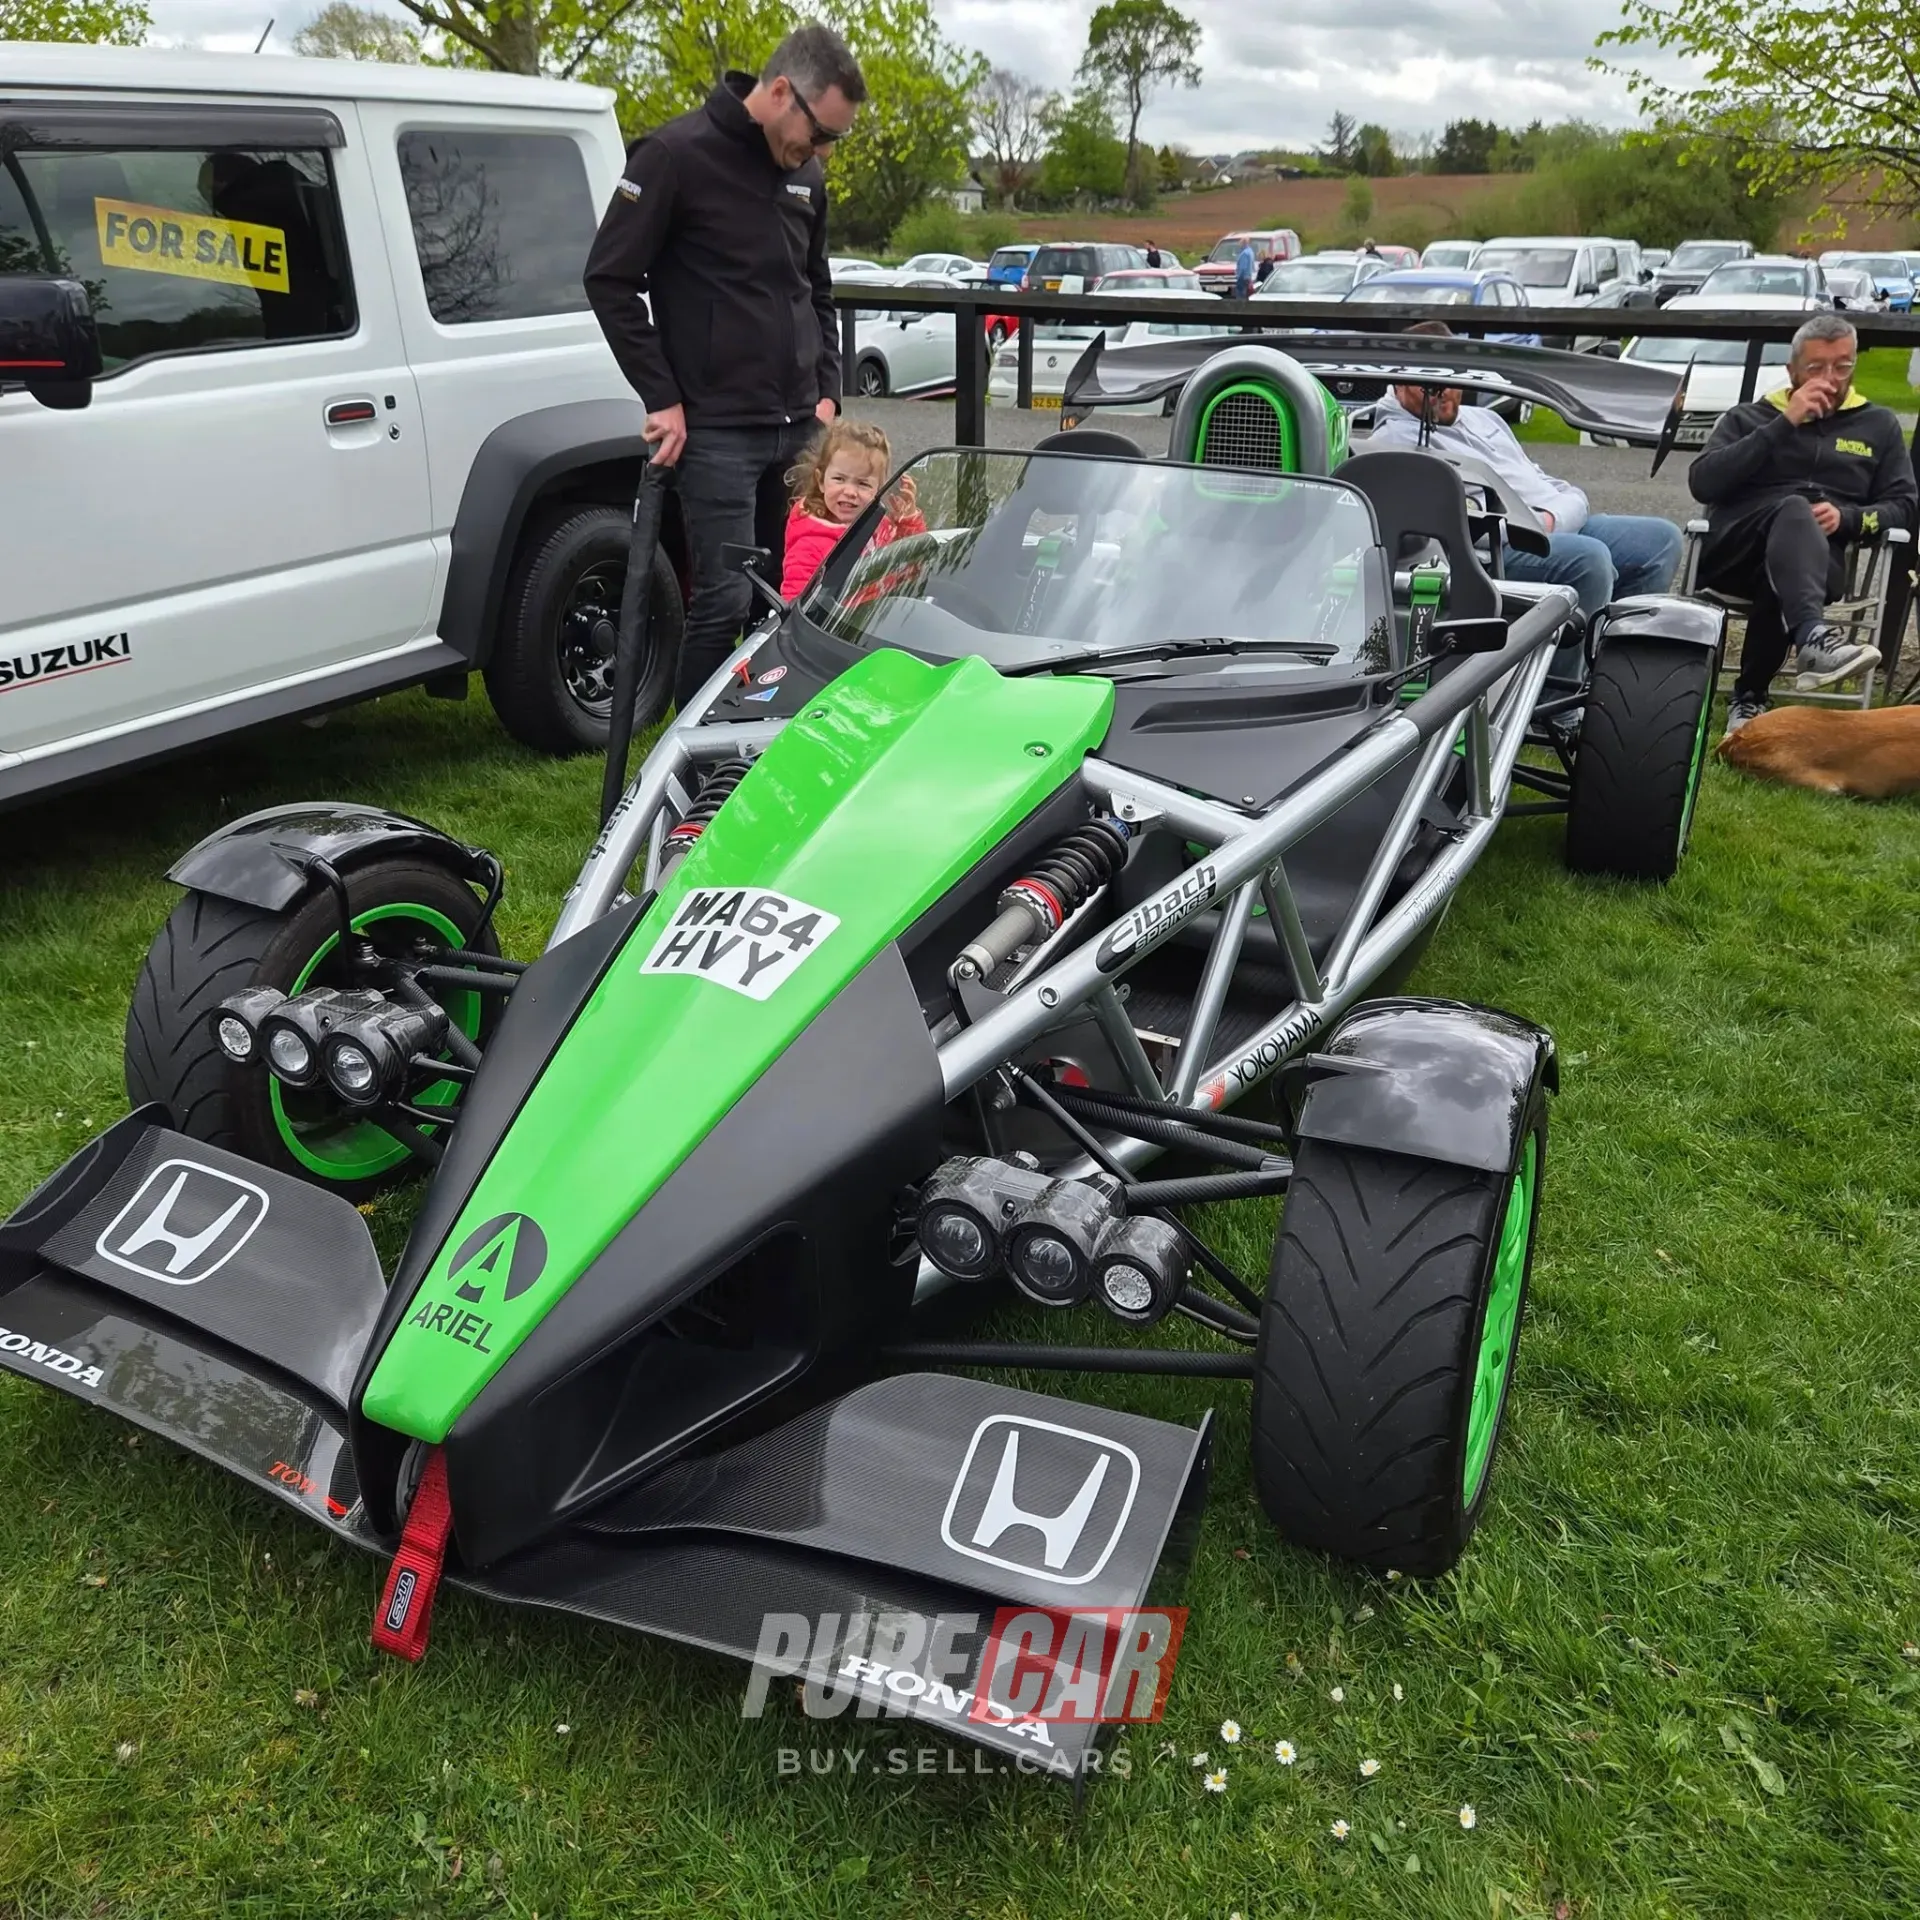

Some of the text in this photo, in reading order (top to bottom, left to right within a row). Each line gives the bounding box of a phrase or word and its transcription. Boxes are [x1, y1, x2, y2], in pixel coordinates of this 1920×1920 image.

[106, 212, 282, 275] FOR SALE
[1302, 363, 1512, 384] ONDA
[1412, 607, 1431, 664] WILLAN
[675, 891, 822, 952] WA64
[1096, 865, 1216, 970] Eibach
[1134, 890, 1210, 954] SPRINGS
[652, 930, 785, 987] HVY
[1228, 1008, 1322, 1089] YOKOHAMA
[408, 1301, 493, 1354] ARIEL
[268, 1461, 318, 1494] TOW
[391, 1577, 413, 1625] TRS
[838, 1655, 1054, 1748] HONDA
